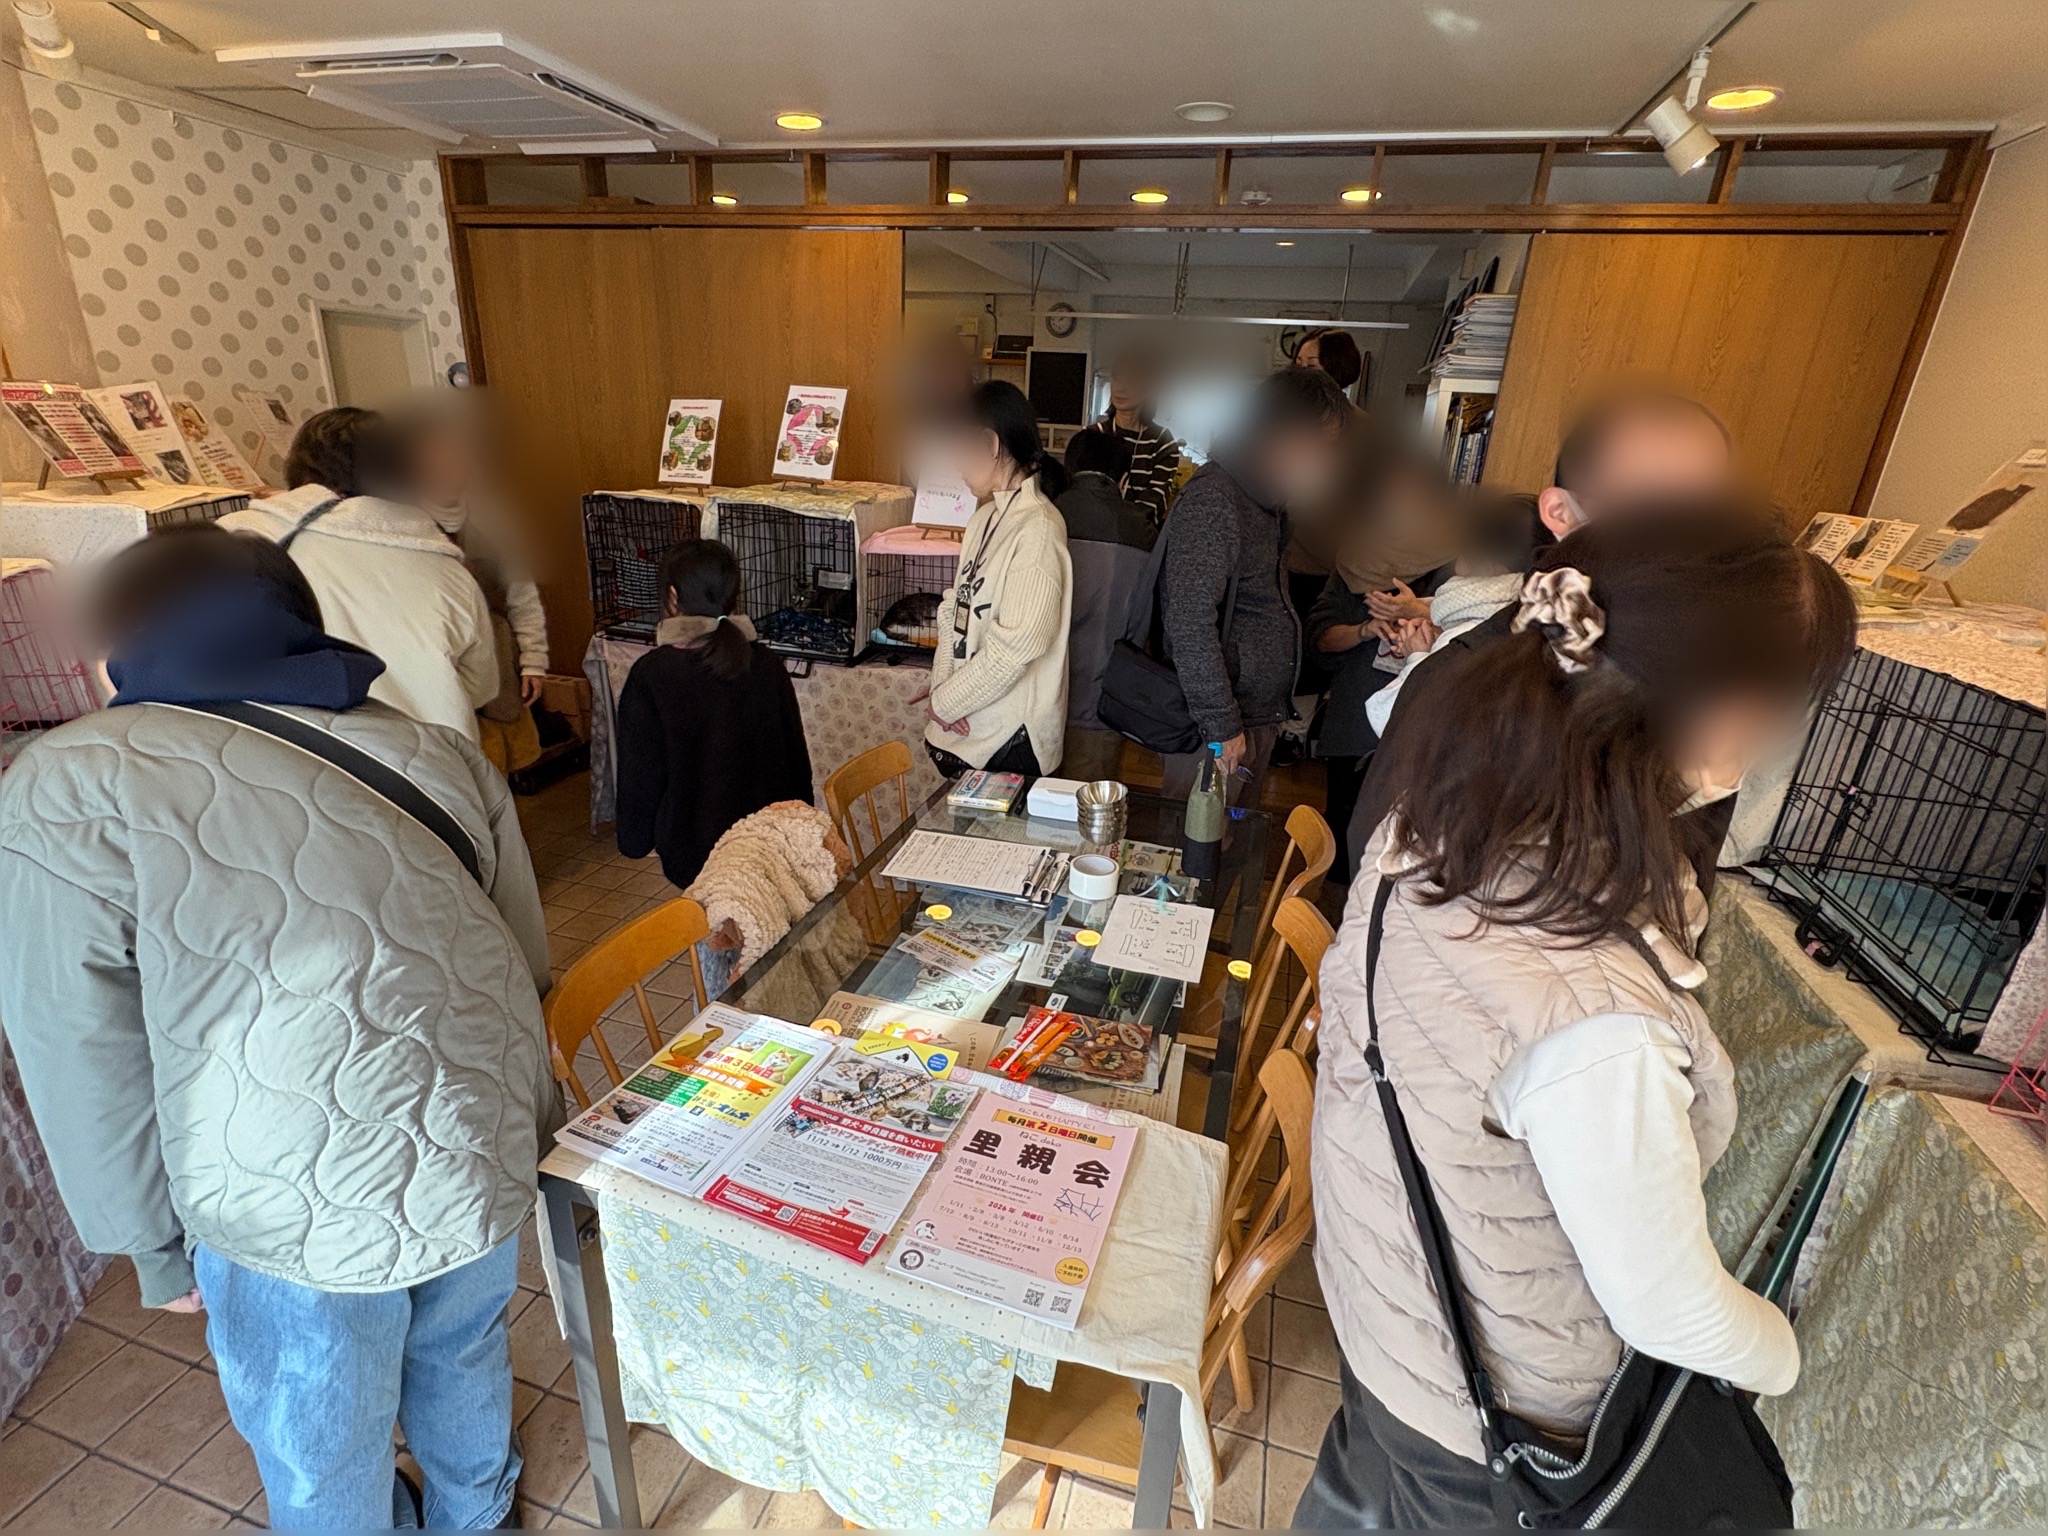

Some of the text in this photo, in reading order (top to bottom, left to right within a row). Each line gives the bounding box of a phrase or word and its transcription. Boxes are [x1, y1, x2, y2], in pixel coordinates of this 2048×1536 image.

[807, 1134, 830, 1147] 11/12
[841, 1145, 860, 1157] 1/12
[862, 1151, 903, 1170] 1000万円
[962, 1129, 1111, 1189] 里親会
